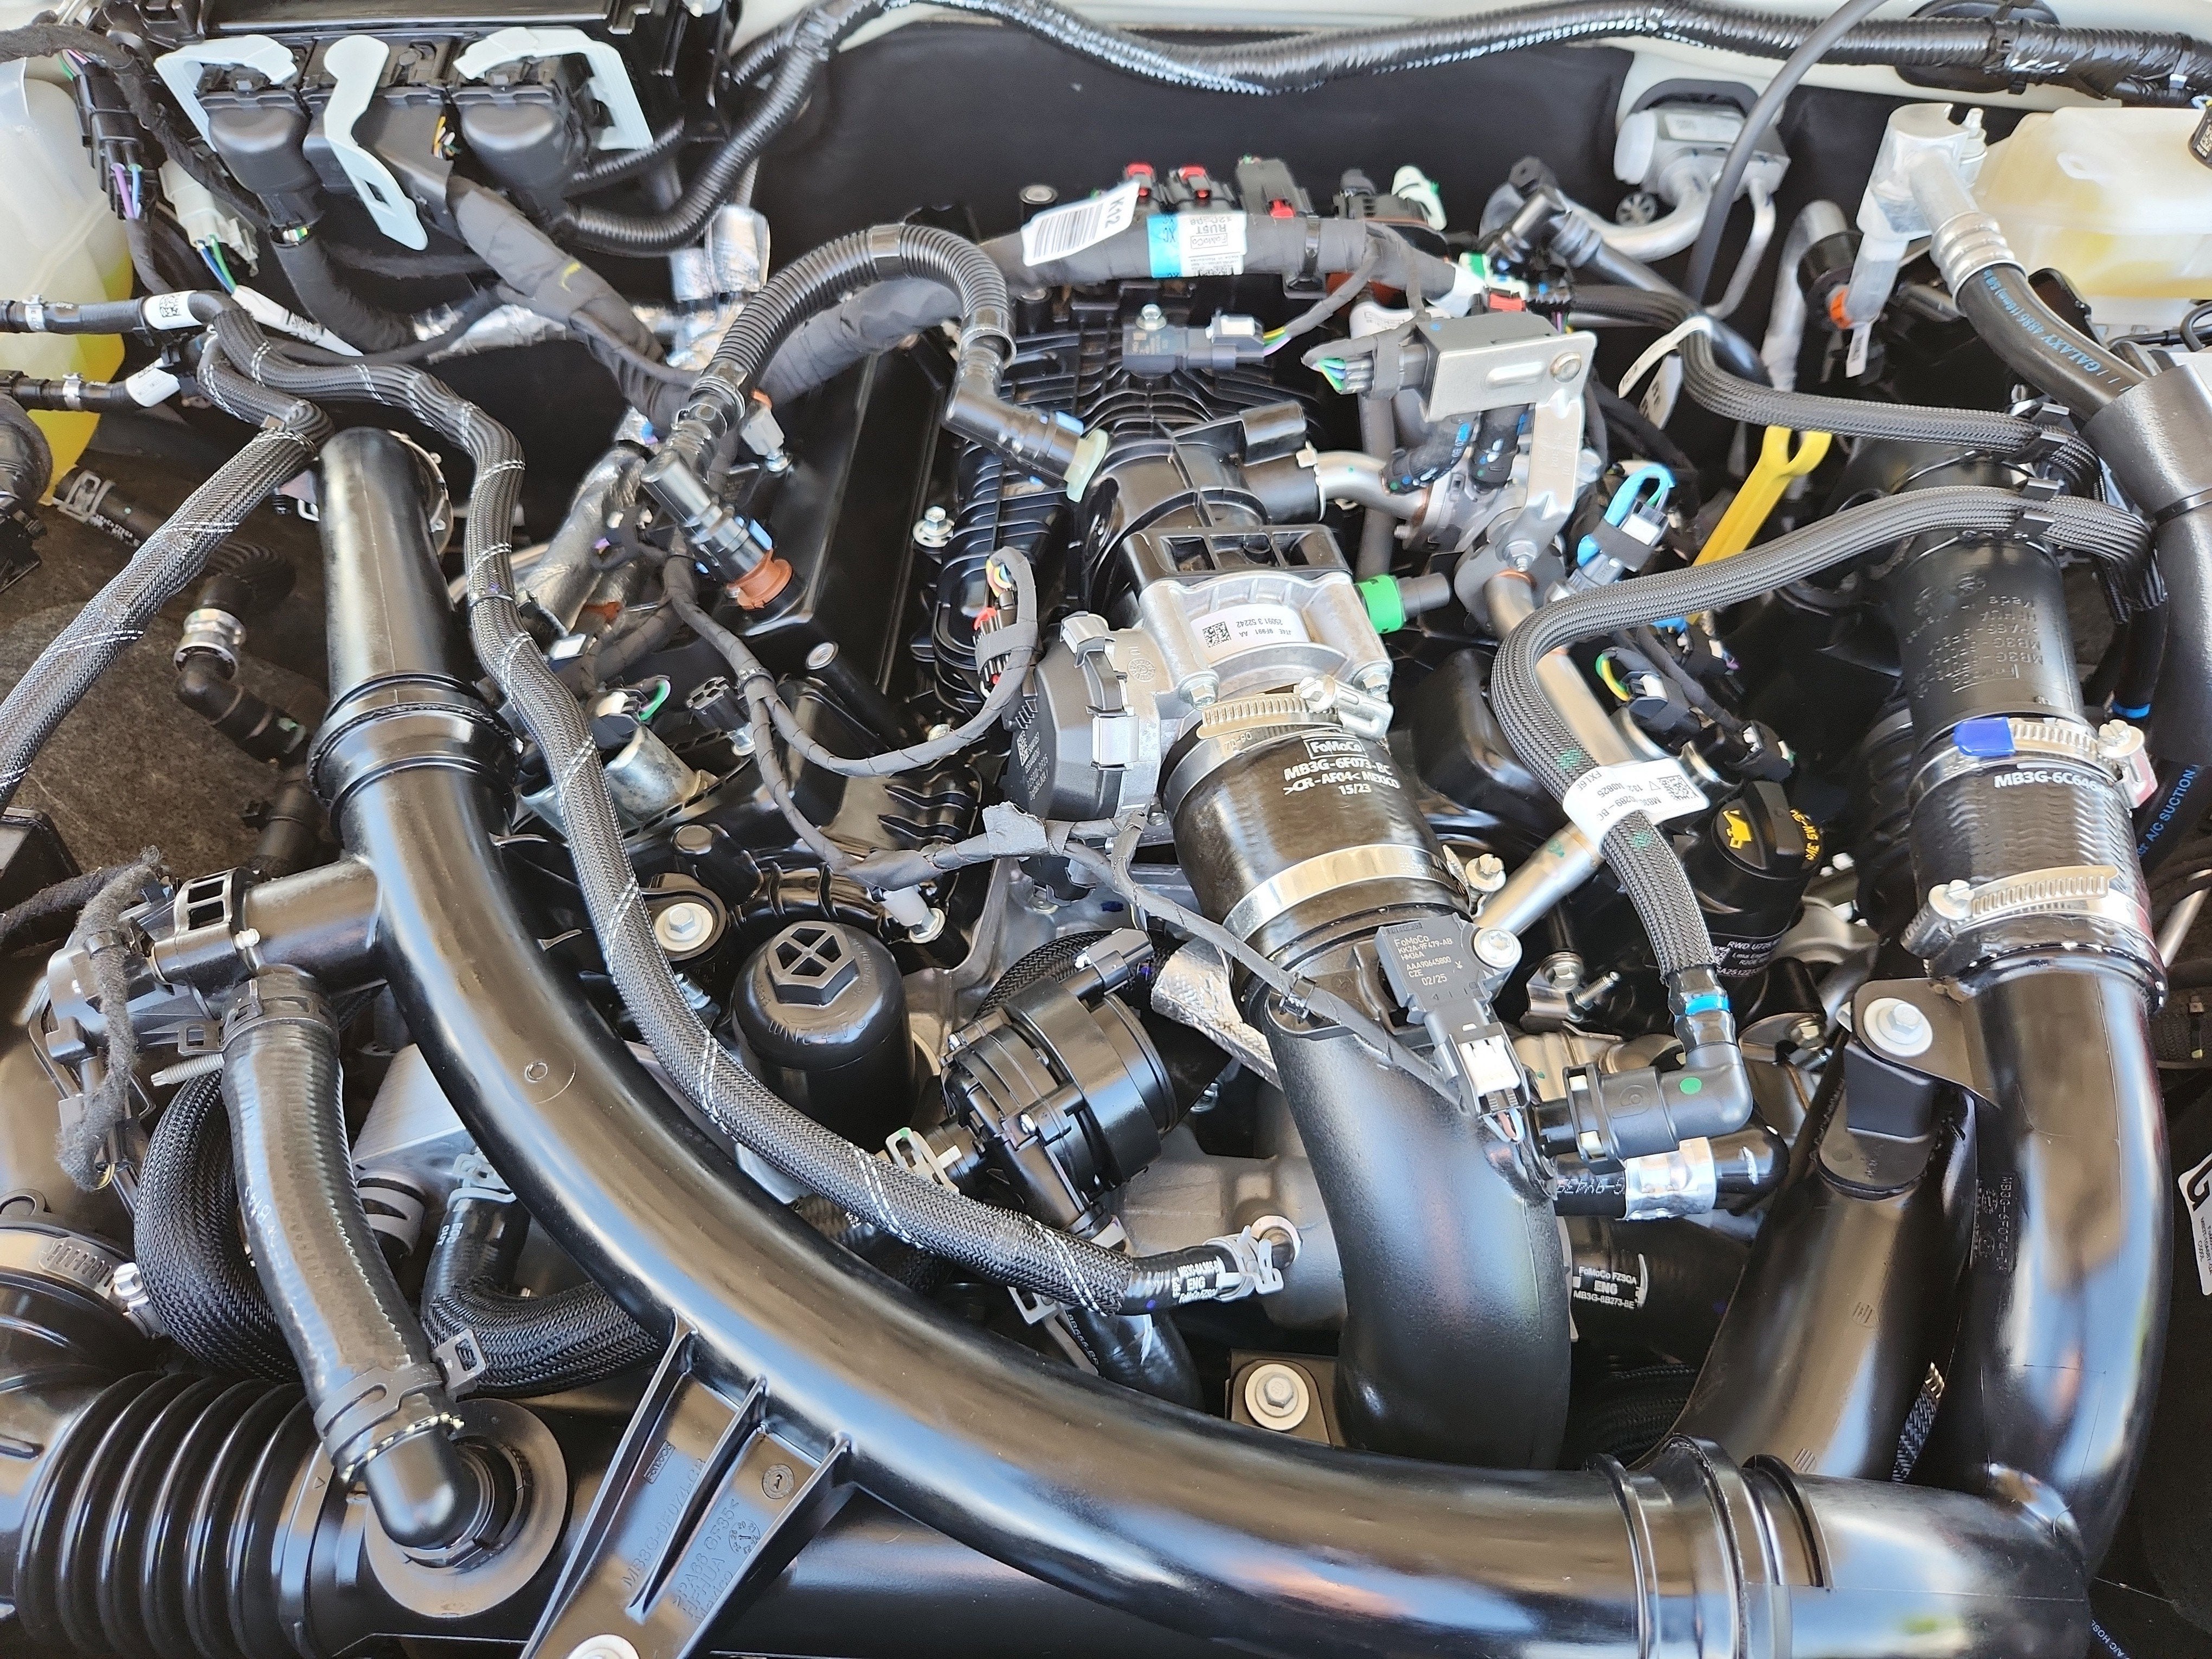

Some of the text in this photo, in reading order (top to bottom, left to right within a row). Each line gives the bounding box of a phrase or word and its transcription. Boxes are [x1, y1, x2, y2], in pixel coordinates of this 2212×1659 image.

[1105, 197, 1125, 229] K12
[2041, 333, 2101, 372] GALAXY
[1236, 619, 1257, 628] 52242
[1309, 741, 1362, 753] FoMoCo
[1283, 757, 1393, 782] MB3G-6F073-BC
[1361, 770, 1401, 789] MEXICO
[1338, 783, 1372, 795] 15/23
[2145, 769, 2196, 842] A/C SUCTION
[1394, 935, 1430, 948] FoMoCo
[1397, 937, 1454, 955] KK2A-9F479-AB
[1727, 941, 1751, 950] RWD
[1400, 951, 1425, 961] HM36A
[1406, 956, 1452, 971] AAA90645800
[1408, 969, 1424, 978] CZE
[1421, 973, 1448, 986] 02/25
[1579, 1266, 1612, 1279] FoMoCo
[1187, 1275, 1206, 1292] ENG
[1593, 1279, 1618, 1296] ENG
[645, 1442, 674, 1483] FoMoCo
